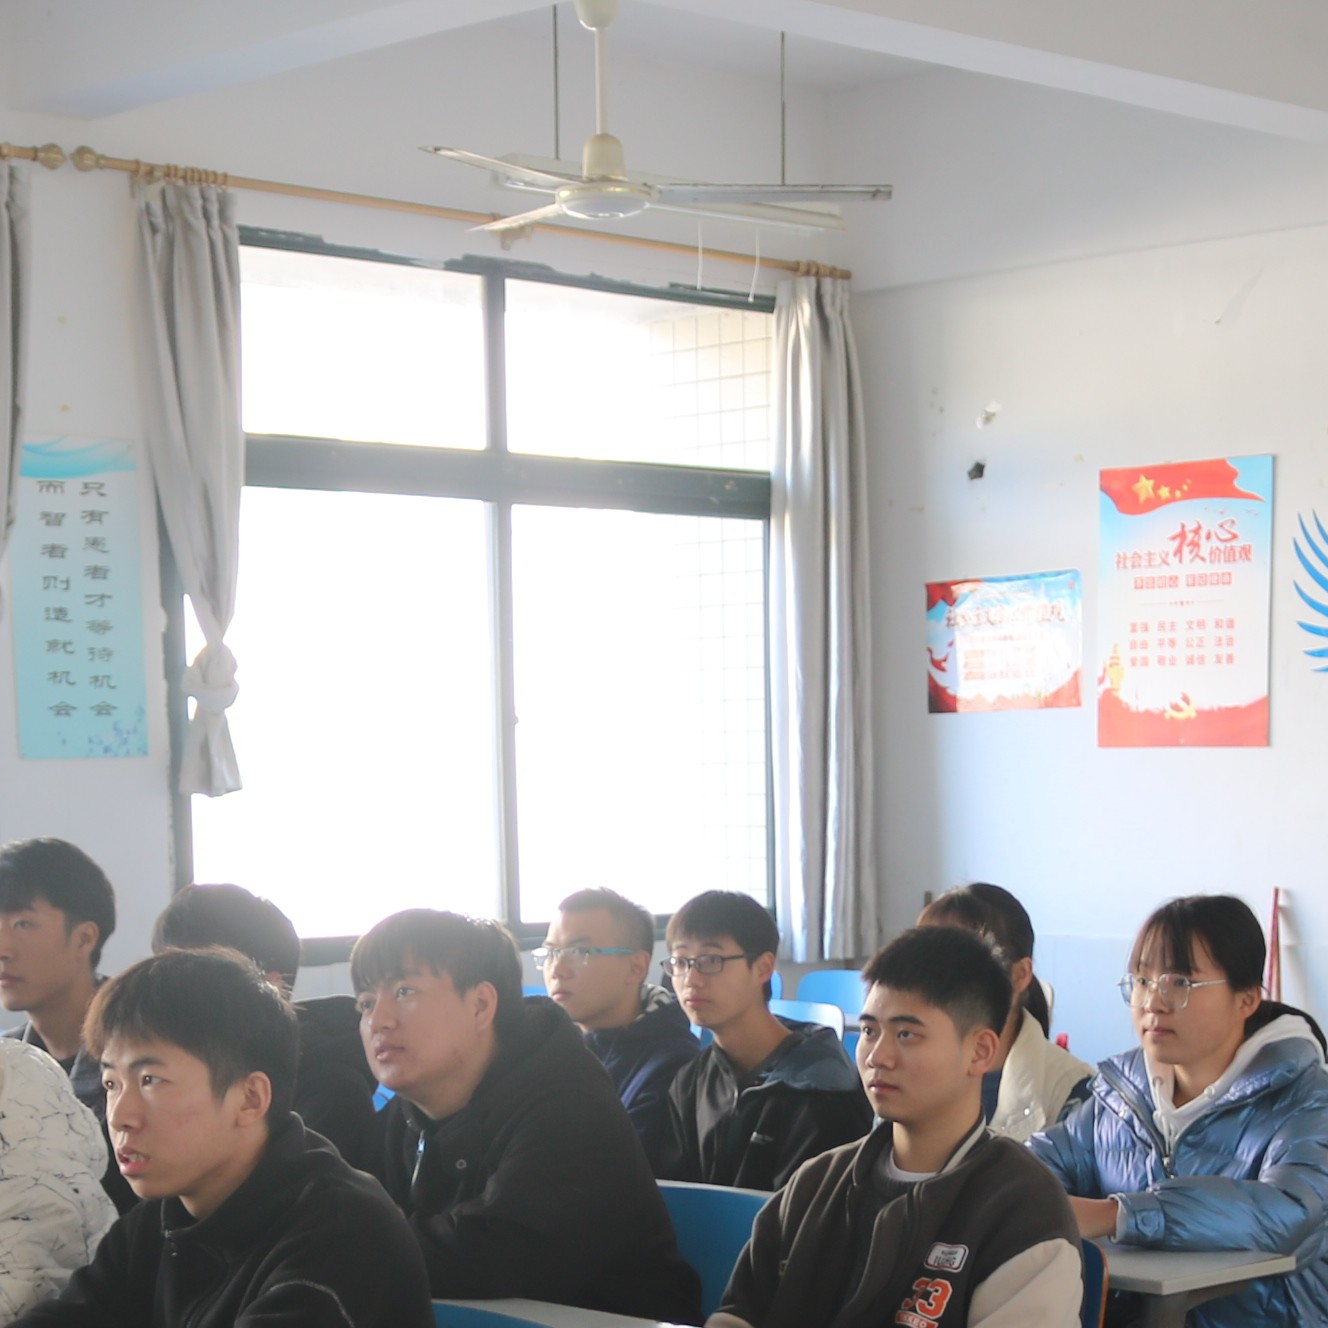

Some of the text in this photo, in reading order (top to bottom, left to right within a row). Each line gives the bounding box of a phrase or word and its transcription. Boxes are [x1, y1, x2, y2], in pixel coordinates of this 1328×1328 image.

[36, 480, 77, 717] 而智者则造就机会
[1115, 518, 1253, 569] 社会主义核心价值观
